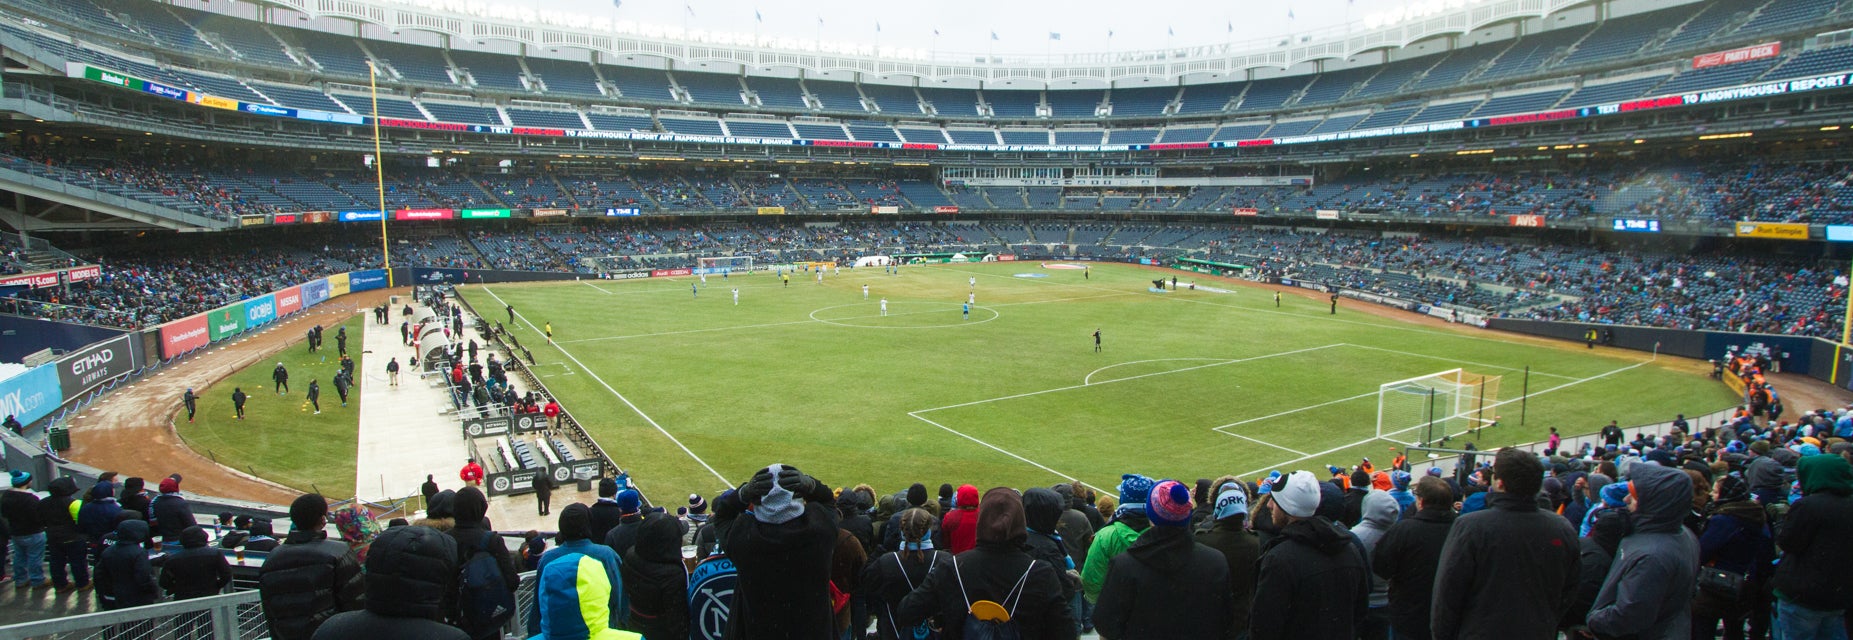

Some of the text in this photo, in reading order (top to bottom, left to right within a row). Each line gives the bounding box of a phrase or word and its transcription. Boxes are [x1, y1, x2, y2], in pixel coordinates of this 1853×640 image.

[1724, 50, 1750, 63] PARTY
[1751, 46, 1774, 59] DECK
[1683, 94, 1699, 104] TO
[1700, 82, 1788, 102] ANONYMOUSLY
[1790, 75, 1846, 91] REPORT
[1597, 103, 1620, 114] TEXT
[428, 121, 467, 131] ACTIVITY
[490, 126, 512, 134] TEXT
[577, 131, 630, 139] ANONYMOUSLY
[674, 135, 724, 143] INAPPROPRIATE
[762, 138, 793, 146] BEHAVIOR
[1515, 214, 1538, 228] AVIS
[1757, 226, 1773, 234] Run
[1775, 227, 1803, 236] Simple
[280, 294, 299, 308] NISSAN
[72, 349, 113, 376] ETIHAD
[82, 367, 108, 386] AIRWAYS
